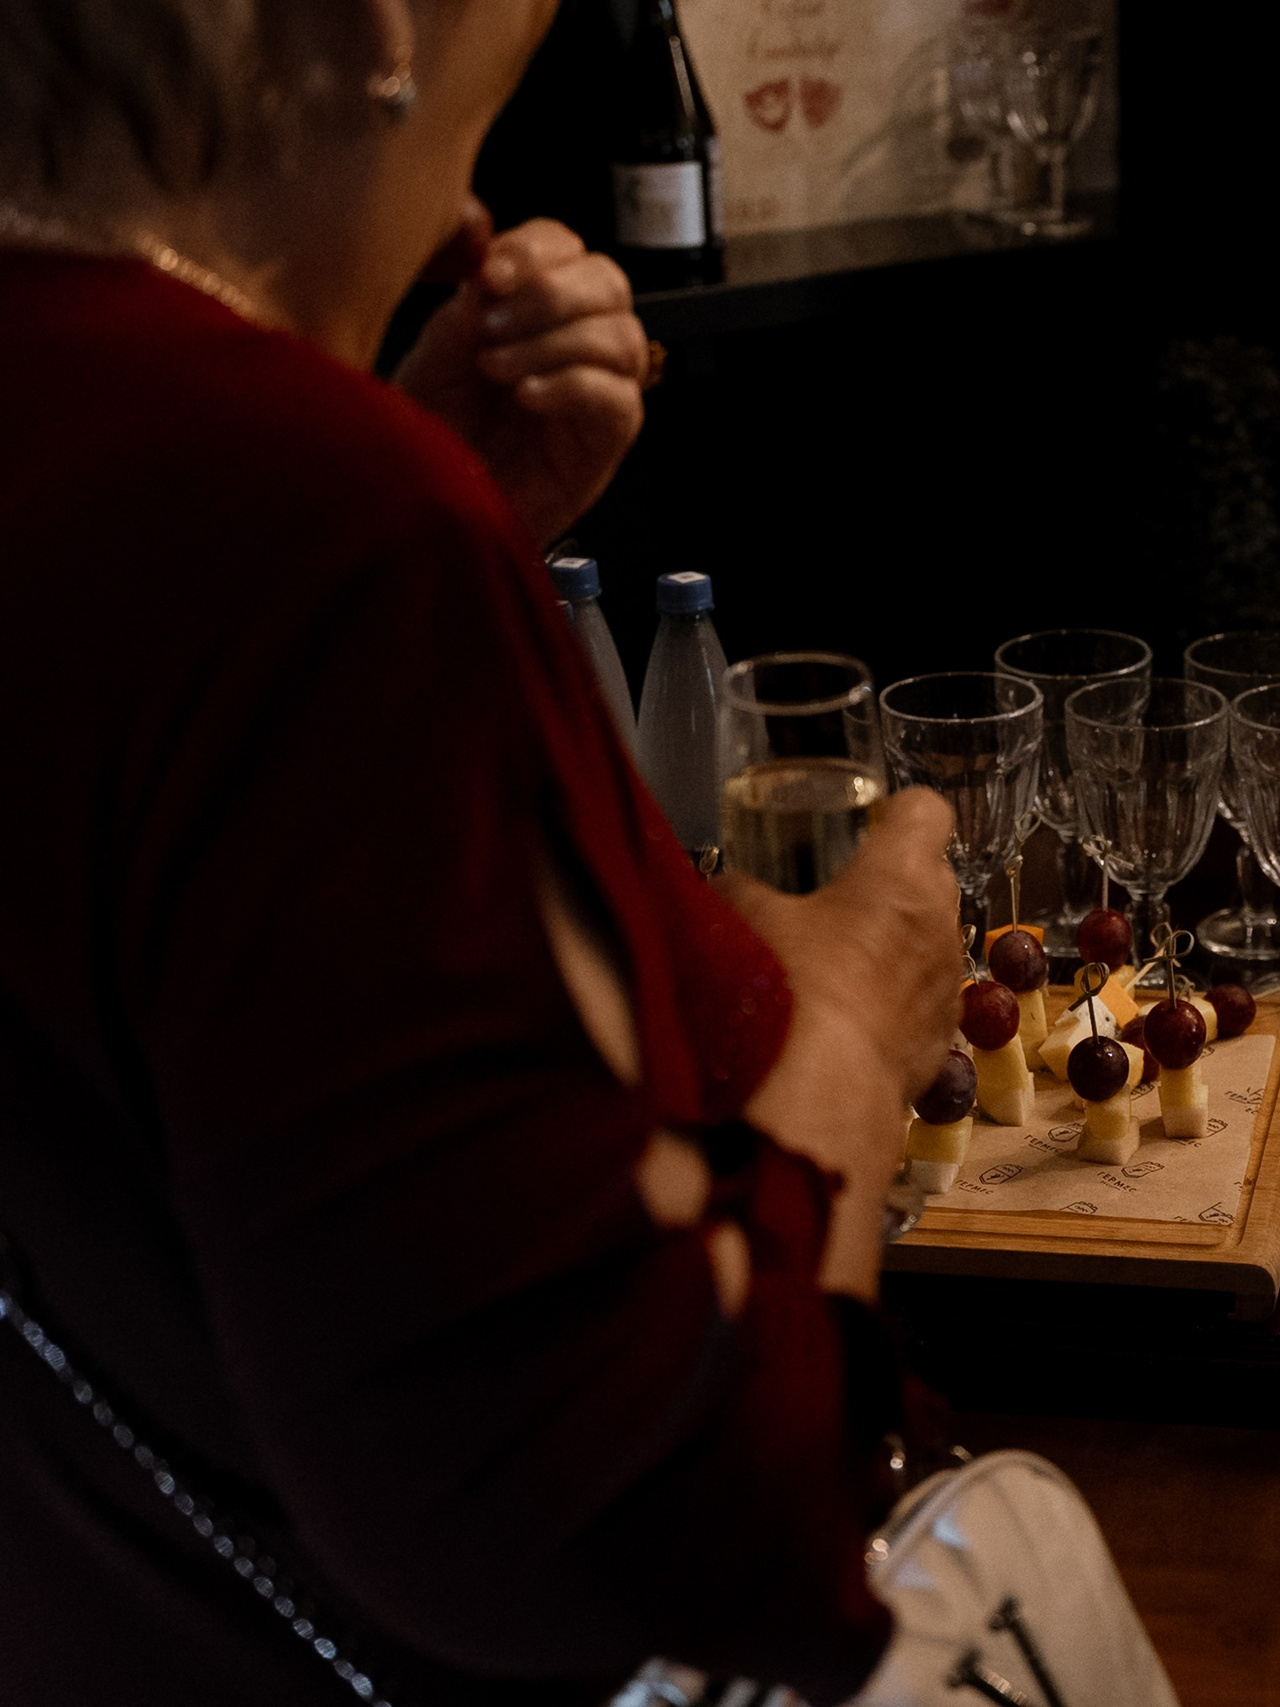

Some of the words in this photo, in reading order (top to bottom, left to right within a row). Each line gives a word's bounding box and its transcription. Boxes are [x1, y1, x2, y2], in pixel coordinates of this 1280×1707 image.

[1024, 1134, 1064, 1152] ГЕРМЕС
[955, 1179, 994, 1195] ГЕРМЕС
[1097, 1171, 1137, 1192] ГЕРМЕС
